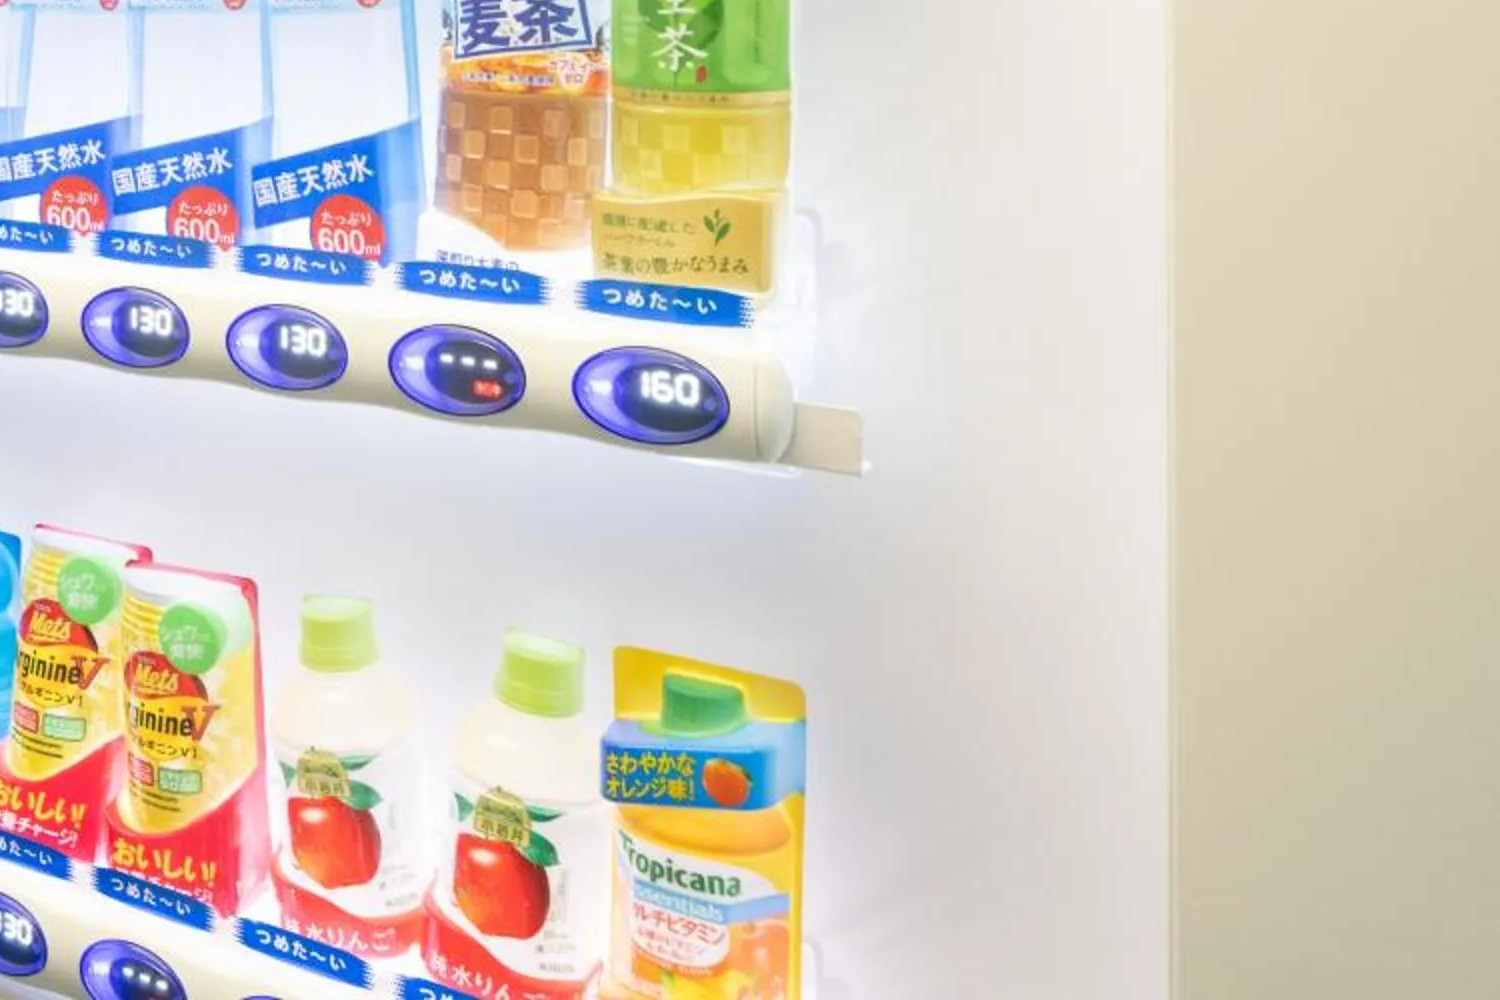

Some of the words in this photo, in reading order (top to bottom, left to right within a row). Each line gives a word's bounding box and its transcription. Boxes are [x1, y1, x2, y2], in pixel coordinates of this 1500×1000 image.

[112, 147, 233, 196] 国産天然水
[252, 154, 374, 208] 国産天然水
[602, 252, 749, 276] 茶葉の豊かなうまみ
[129, 305, 174, 337] 130
[279, 324, 329, 359] 130
[639, 370, 702, 407] 160
[605, 753, 697, 777] さわやかな
[617, 829, 741, 898] Tropicana
